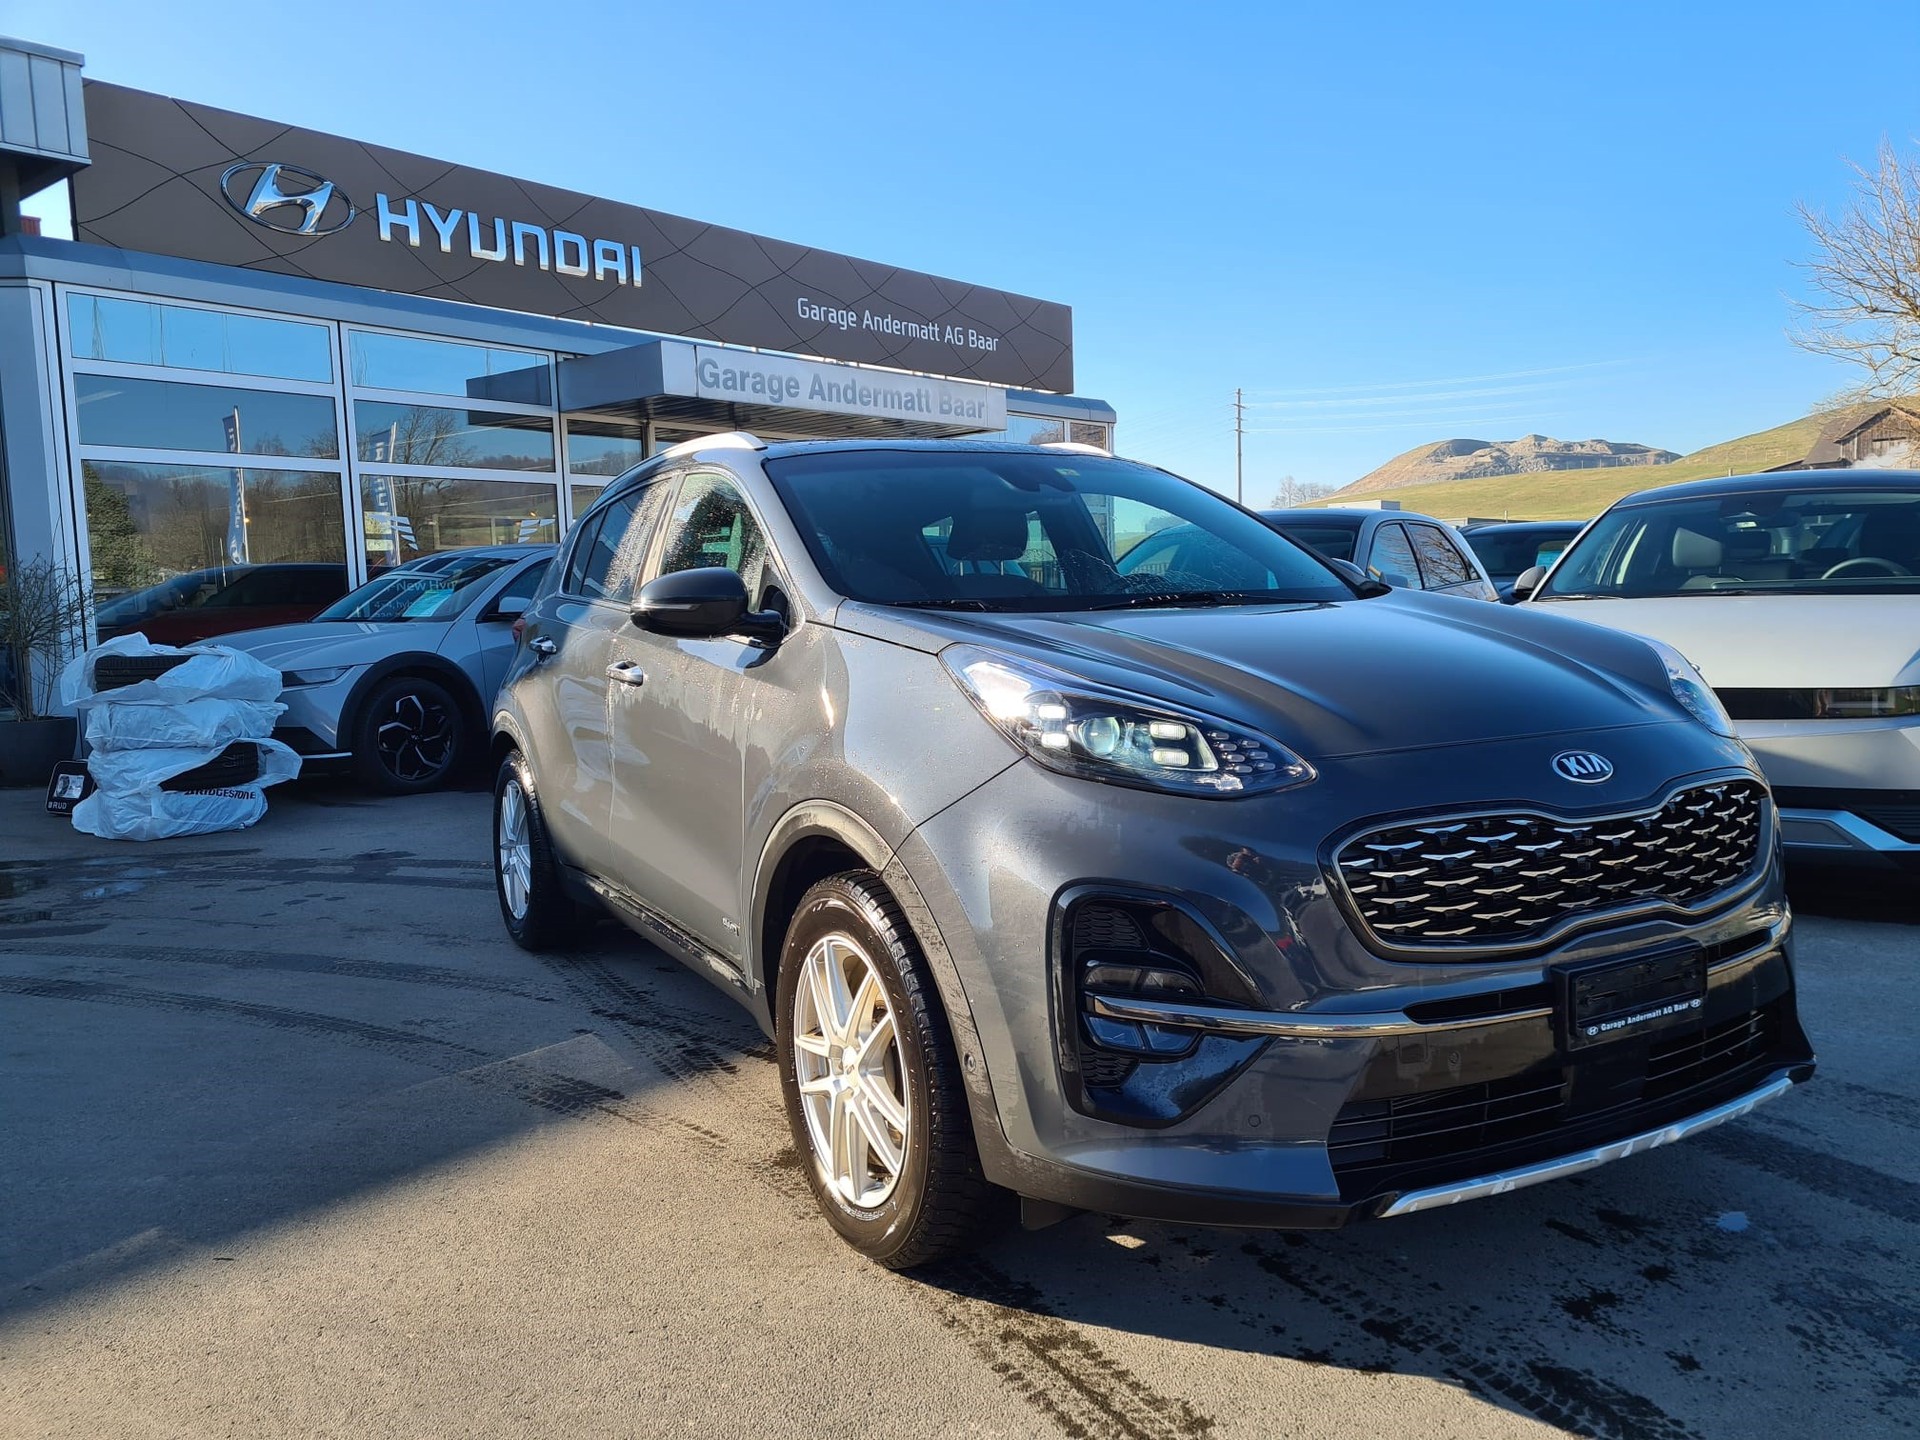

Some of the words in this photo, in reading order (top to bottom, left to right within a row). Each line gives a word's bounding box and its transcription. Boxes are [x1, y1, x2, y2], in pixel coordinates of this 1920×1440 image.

[375, 192, 642, 287] HYUNDAI
[797, 297, 857, 330] Garage
[863, 309, 940, 342] Andermatt
[944, 325, 964, 346] AG
[968, 329, 999, 351] Baar
[700, 357, 800, 403] Garage
[808, 373, 932, 414] Andermatt
[938, 392, 985, 419] Baar
[1560, 754, 1610, 776] KIA
[1601, 1019, 1626, 1032] Garage
[1627, 1008, 1662, 1024] Andermatt
[1663, 1006, 1673, 1015] AG
[1674, 1002, 1689, 1012] Baar
